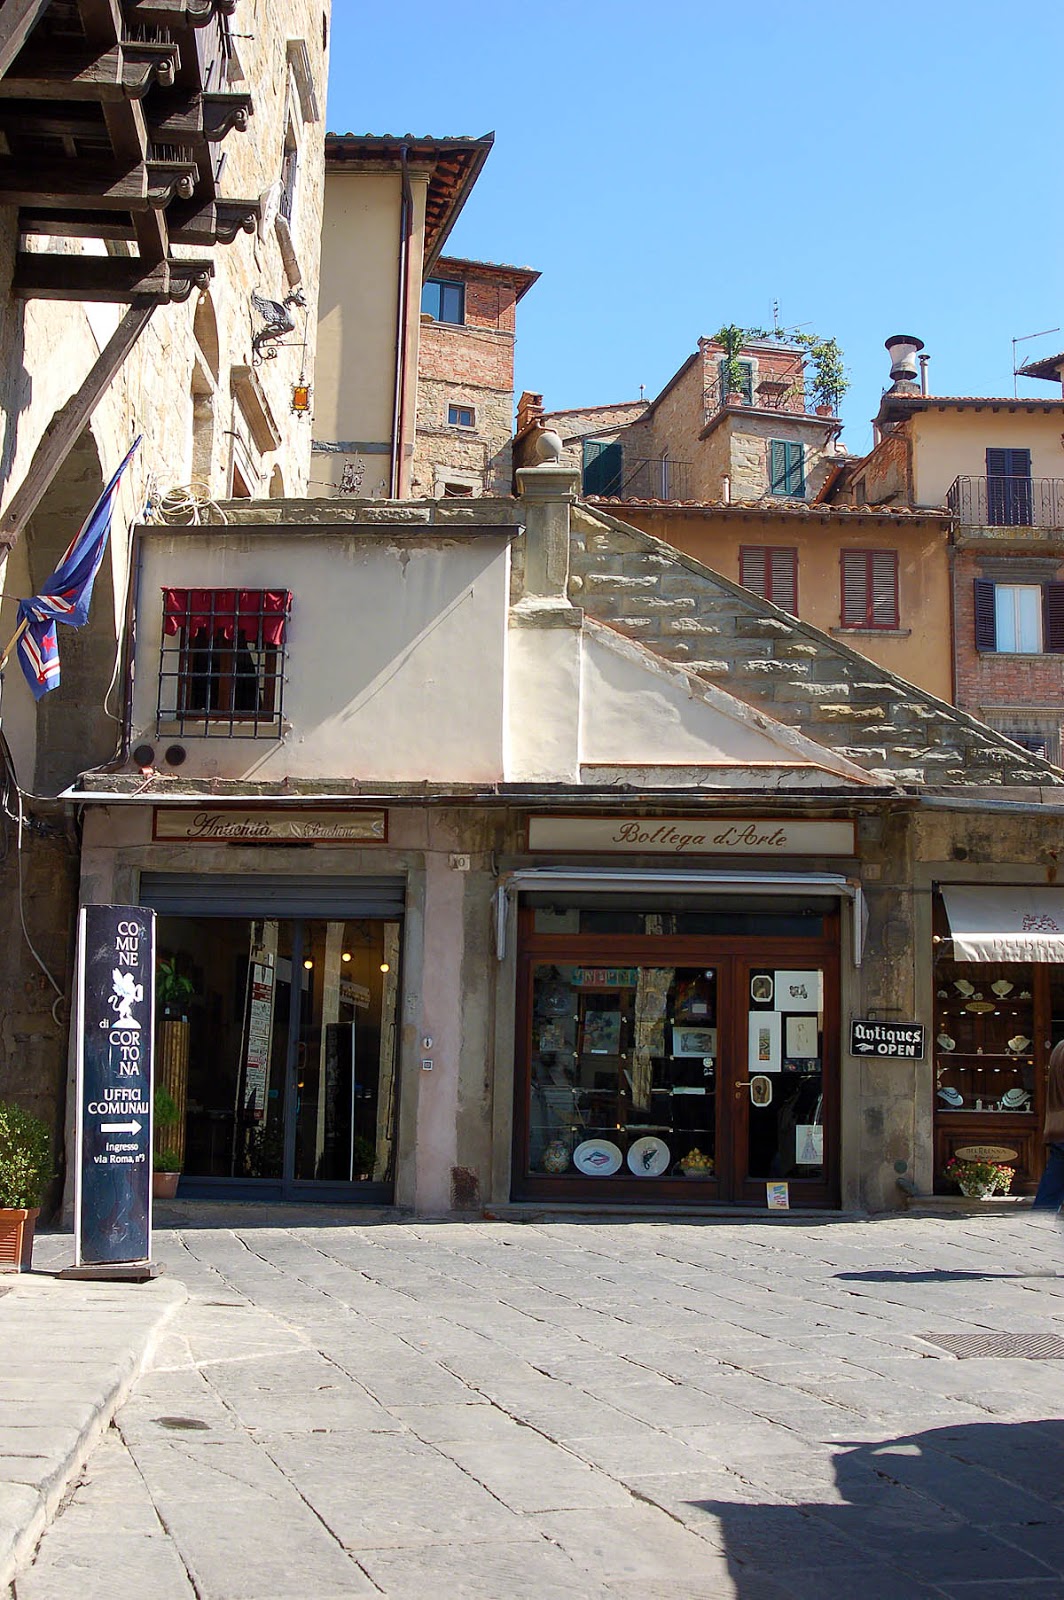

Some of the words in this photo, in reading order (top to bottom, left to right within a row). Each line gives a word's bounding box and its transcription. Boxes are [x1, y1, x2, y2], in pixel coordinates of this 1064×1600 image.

[612, 822, 705, 850] Bottega
[713, 824, 787, 846] d'Arte
[118, 921, 139, 936] CO
[115, 936, 139, 951] MU
[119, 952, 139, 966] NE
[99, 1019, 109, 1029] di
[109, 1031, 140, 1046] COR
[855, 1024, 921, 1043] Antiques
[121, 1046, 140, 1061] TO
[877, 1043, 915, 1056] OPEN
[119, 1061, 140, 1076] NA
[104, 1088, 141, 1101] UFFICI
[88, 1101, 149, 1114] COMUNALI
[94, 1155, 108, 1164] via
[110, 1154, 134, 1164] Roma,
